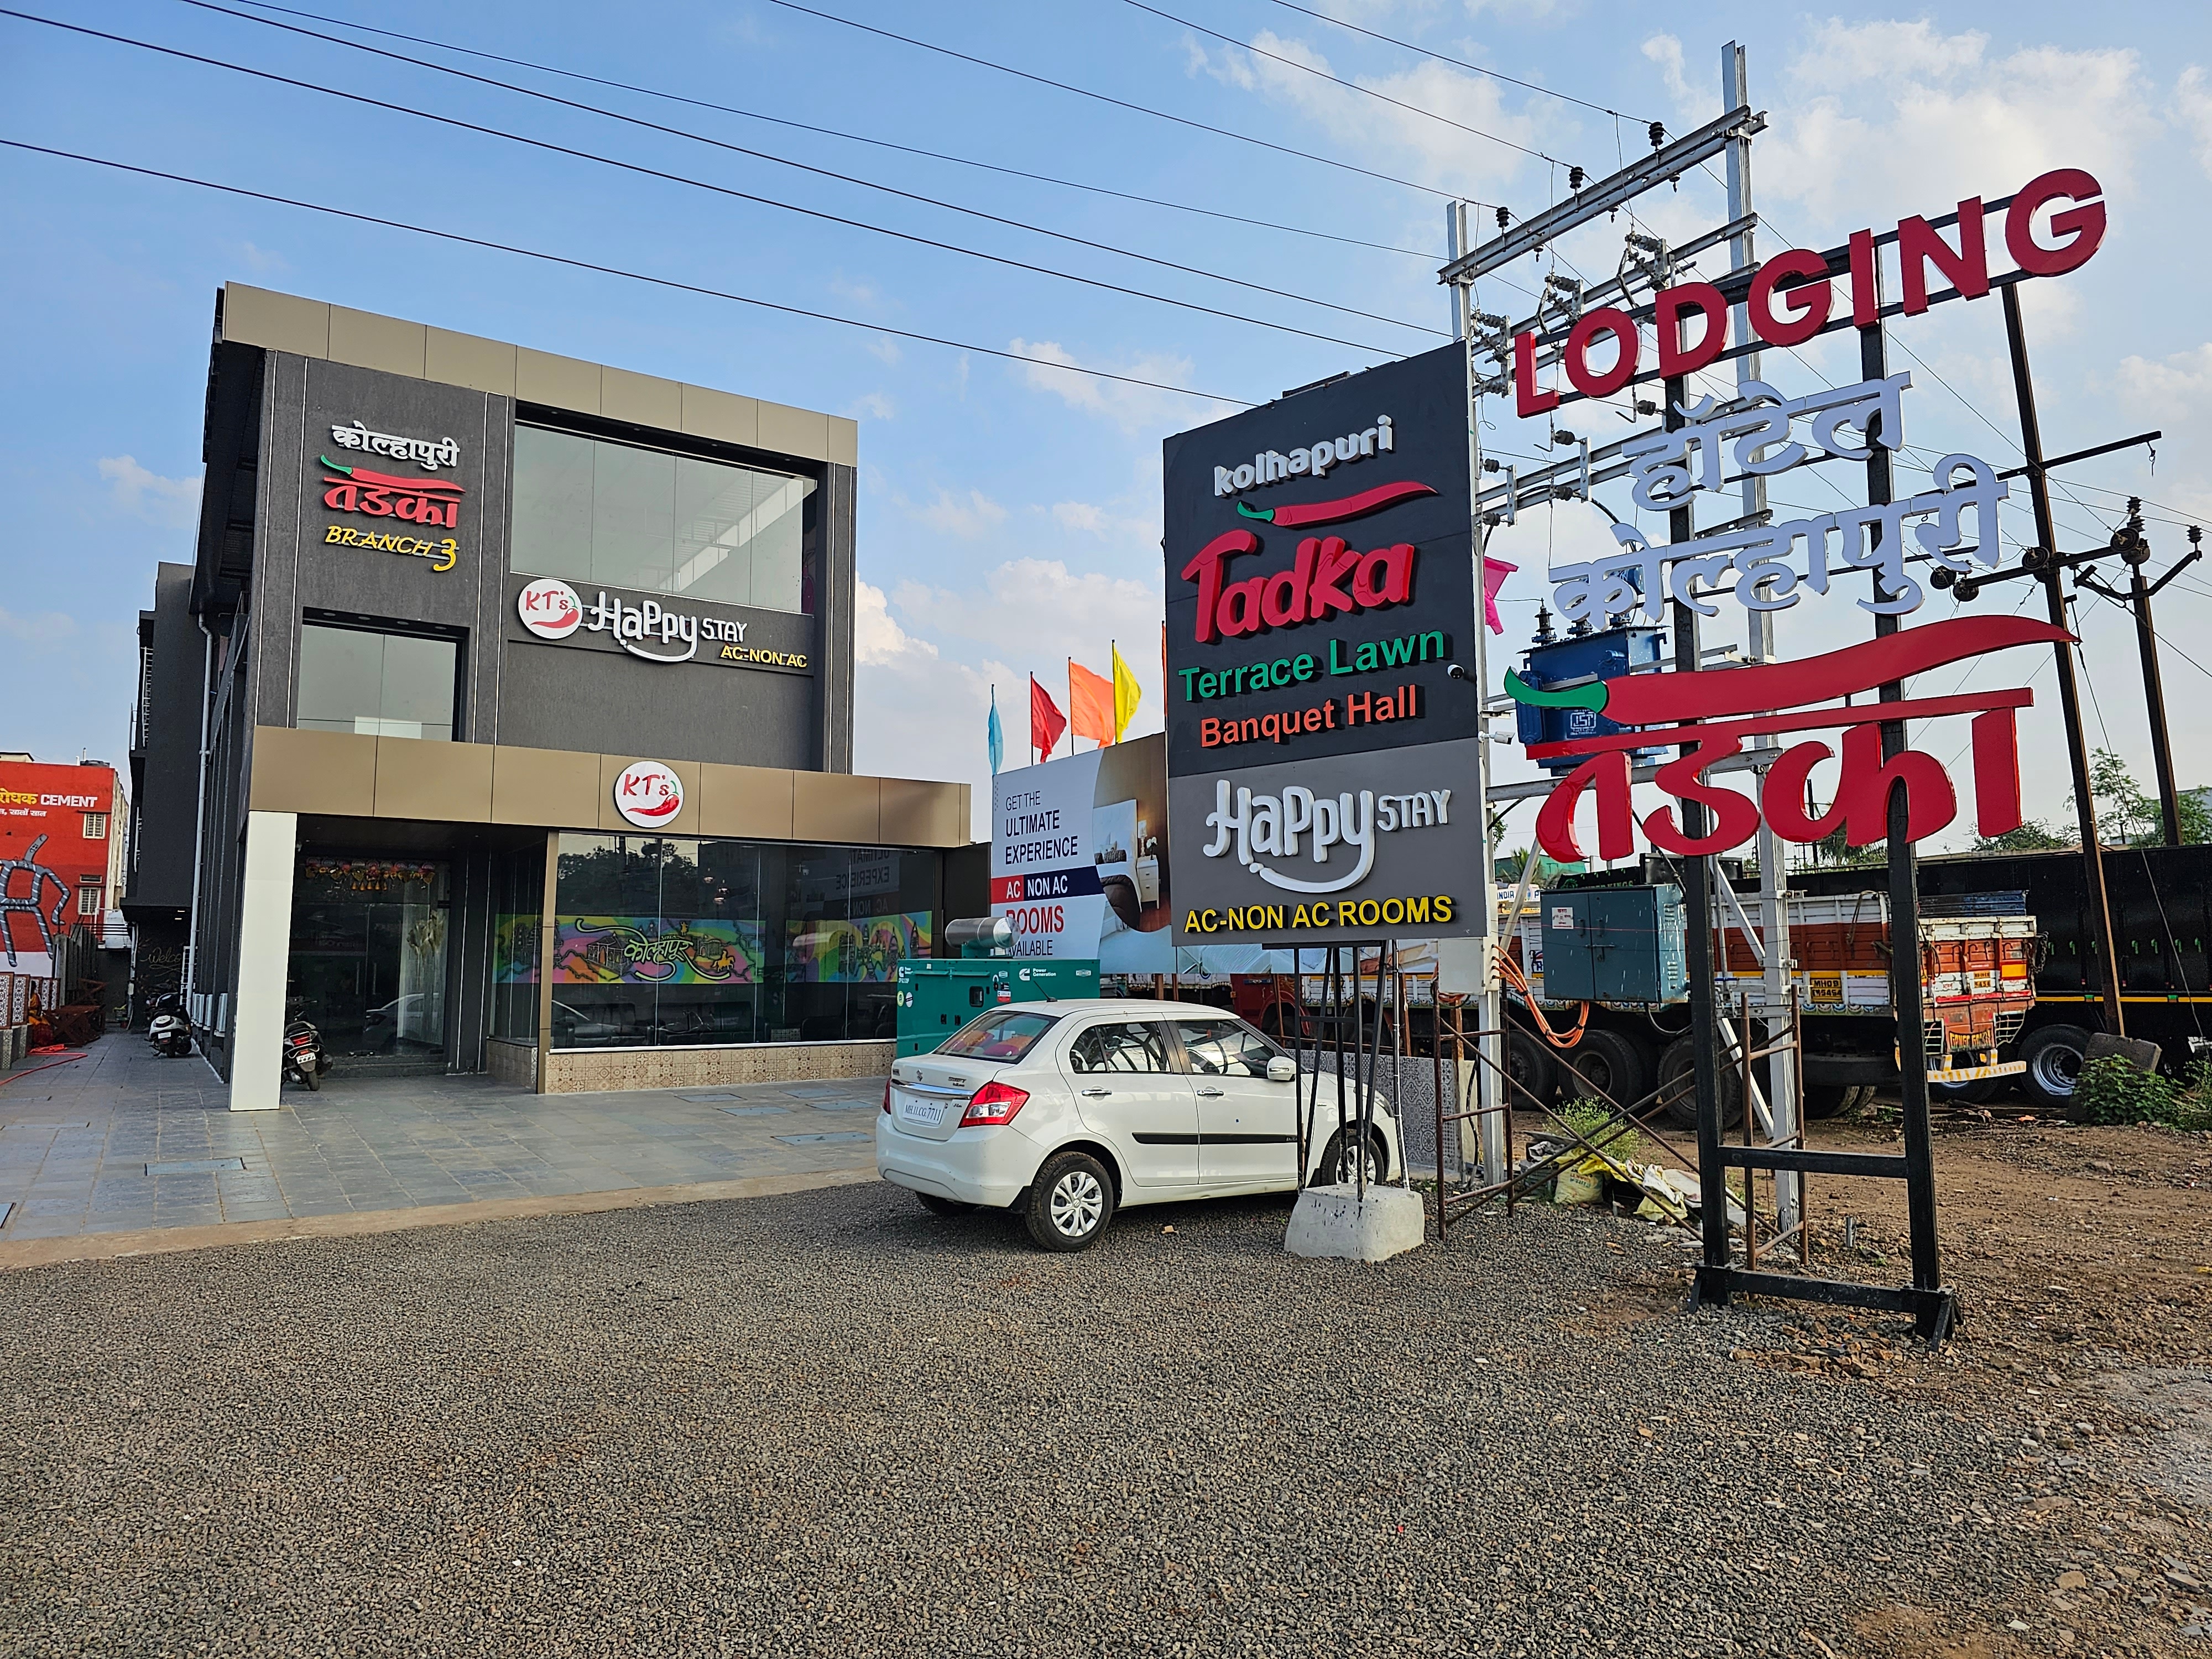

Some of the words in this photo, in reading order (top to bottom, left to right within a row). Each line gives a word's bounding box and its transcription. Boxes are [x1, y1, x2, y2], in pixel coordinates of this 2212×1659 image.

[1514, 168, 2107, 419] LODGING
[331, 420, 460, 471] कोल्हापुरी
[1214, 414, 1393, 497] kolhapuri
[1622, 370, 1913, 512] हॉटेल
[324, 477, 461, 529] तडका
[325, 526, 434, 556] BRANCH
[433, 538, 457, 572] 3
[1548, 453, 2010, 632] कोल्हापुरी
[525, 591, 568, 611] KT's
[1181, 529, 1416, 643] Tadka
[701, 617, 748, 643] STAY
[721, 645, 783, 665] AC-NON
[786, 654, 807, 668] AC
[1178, 654, 1314, 702] Terrace
[1330, 630, 1445, 676] Lawn
[1201, 700, 1335, 748] Banquet
[1348, 685, 1416, 725] Hall
[623, 774, 670, 796] KT's
[1526, 687, 2033, 864] तडका
[40, 794, 98, 807] CEMENT
[1006, 795, 1022, 811] GET
[1024, 791, 1041, 807] THE
[1378, 789, 1452, 832] STAY
[1006, 810, 1060, 837] ULTIMATE
[1005, 836, 1078, 865] EXPERIENCE
[1006, 880, 1021, 899] AC
[1027, 877, 1050, 897] NON
[1052, 875, 1068, 894] AC
[1184, 905, 1284, 933] AC-NON
[1292, 902, 1330, 928] AC
[1339, 895, 1453, 926] ROOMS
